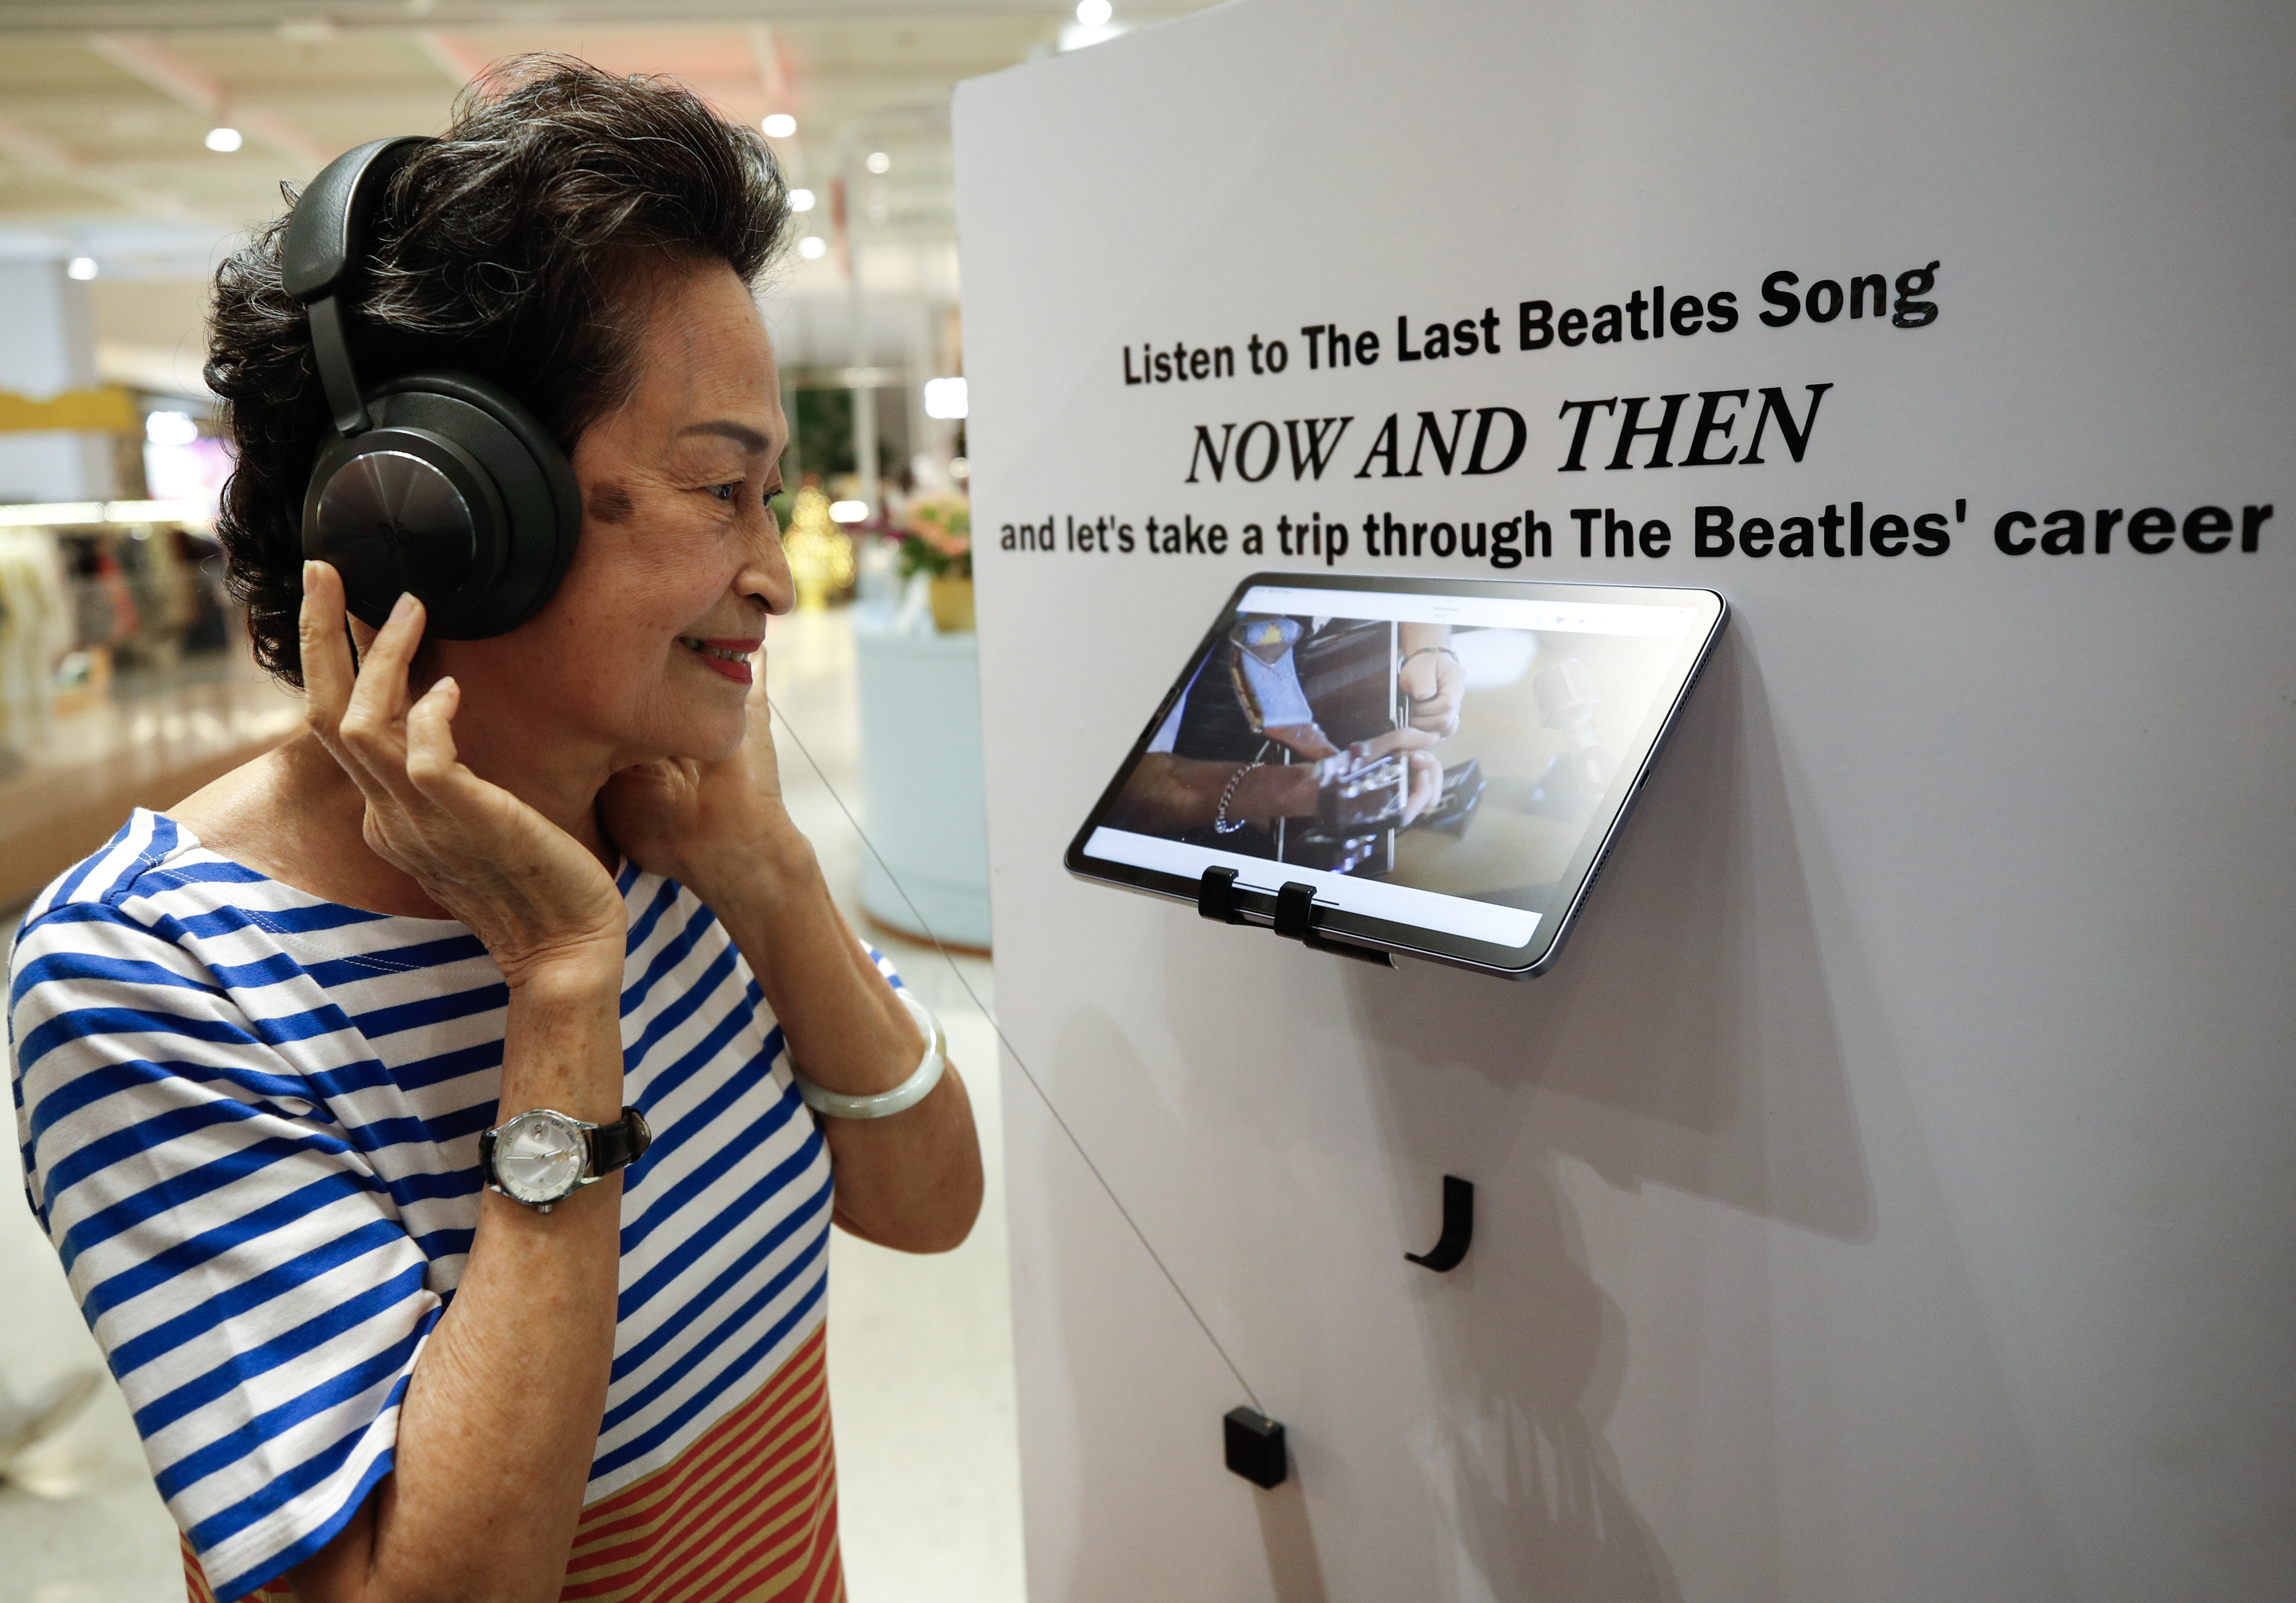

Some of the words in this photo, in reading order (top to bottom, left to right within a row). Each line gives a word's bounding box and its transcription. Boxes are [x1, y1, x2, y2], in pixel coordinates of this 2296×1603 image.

[1123, 342, 1235, 386] Listen
[1247, 334, 1289, 375] to
[1300, 324, 1380, 370] The
[1397, 306, 1502, 363] Last
[1518, 285, 1739, 351] Beatles
[1758, 259, 1941, 329] Song
[1185, 415, 1354, 483] NOW
[1354, 408, 1528, 479] AND
[1557, 382, 1834, 472] THEN
[1001, 516, 1055, 552] and
[1066, 515, 1136, 553] let's
[1145, 515, 1228, 555] take
[1241, 523, 1263, 556] a
[1276, 511, 1350, 567] trip
[1362, 509, 1553, 570] through
[1569, 507, 1672, 559] The
[1694, 501, 1967, 559] Beatles'
[1992, 503, 2275, 557] career
